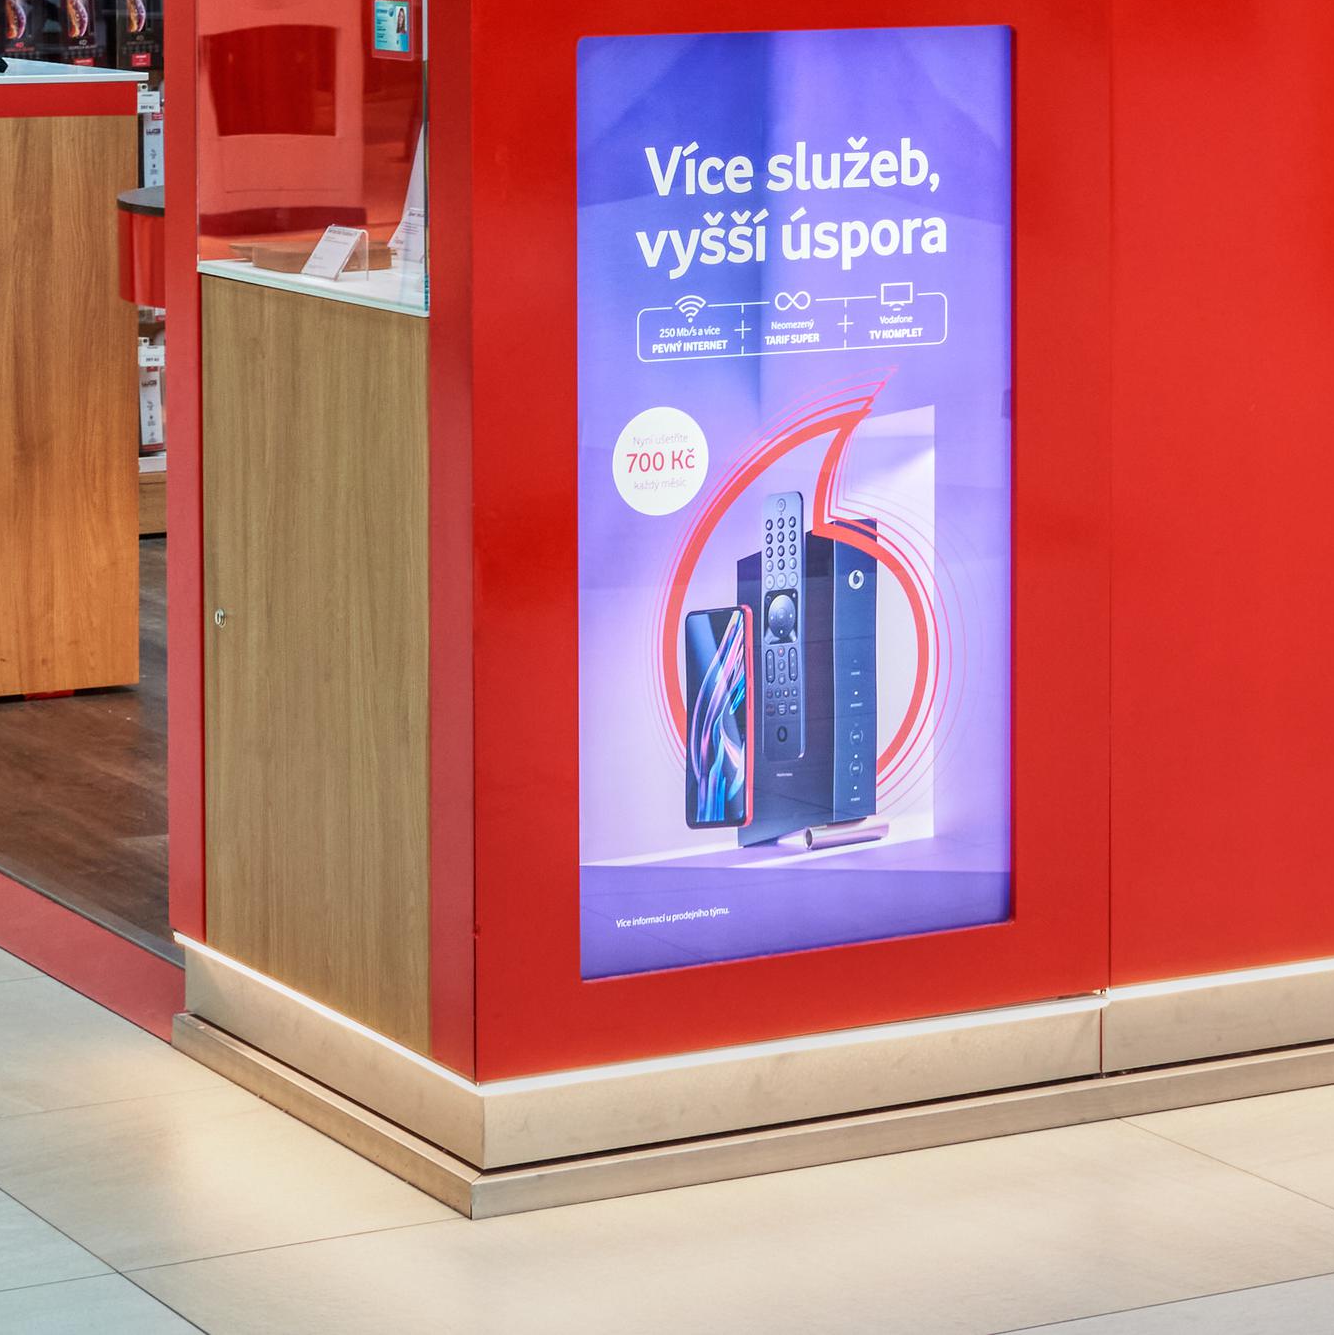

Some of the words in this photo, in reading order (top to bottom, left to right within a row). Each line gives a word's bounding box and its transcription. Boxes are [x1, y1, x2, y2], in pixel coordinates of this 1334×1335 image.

[644, 141, 754, 197] Více
[766, 136, 941, 193] služeb,
[635, 208, 769, 280] vyšší
[781, 206, 948, 271] úspora
[771, 319, 815, 331] Neomezený
[879, 315, 914, 325] Vodafone
[659, 328, 675, 338] 250
[676, 326, 697, 337] Mb/s
[704, 325, 720, 335] více
[869, 329, 882, 340] TV
[882, 327, 923, 339] KOMPLET
[652, 340, 682, 354] PEVNÝ
[683, 339, 728, 351] INTERNET
[765, 334, 790, 346] TARIF
[791, 333, 820, 344] SUPER
[626, 451, 665, 473] 700
[671, 447, 696, 470] Kč
[615, 918, 632, 928] Více
[632, 913, 665, 926] informací
